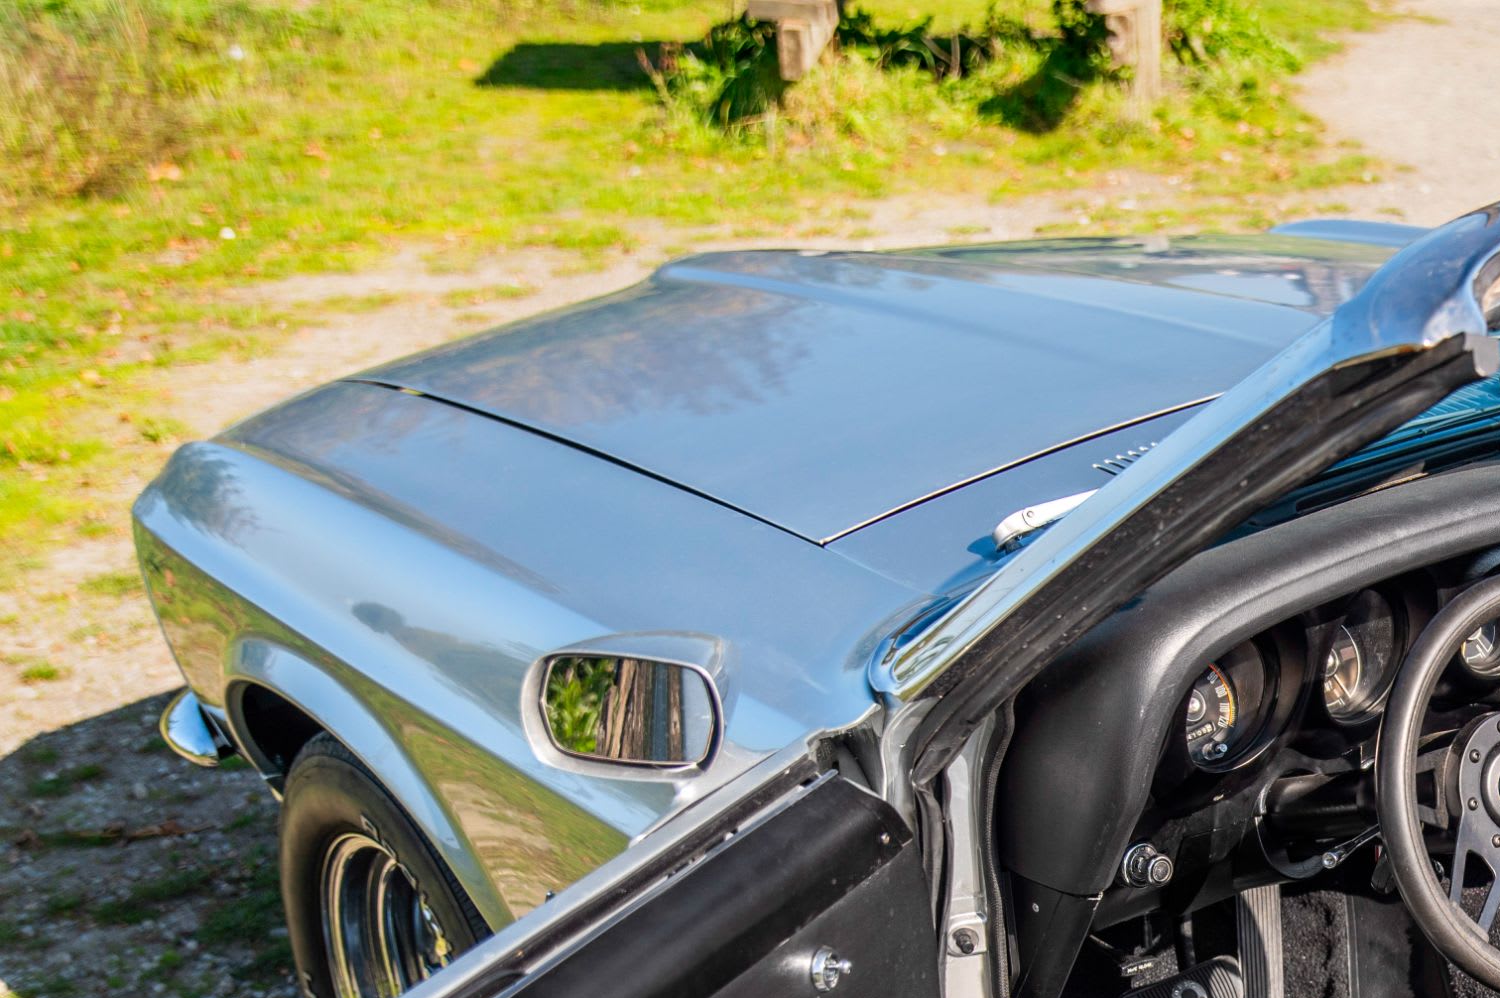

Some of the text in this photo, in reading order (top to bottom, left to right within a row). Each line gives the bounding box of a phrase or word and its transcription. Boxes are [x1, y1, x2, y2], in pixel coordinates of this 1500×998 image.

[1214, 684, 1228, 698] 100
[1219, 702, 1230, 713] 110
[1217, 715, 1229, 729] 120
